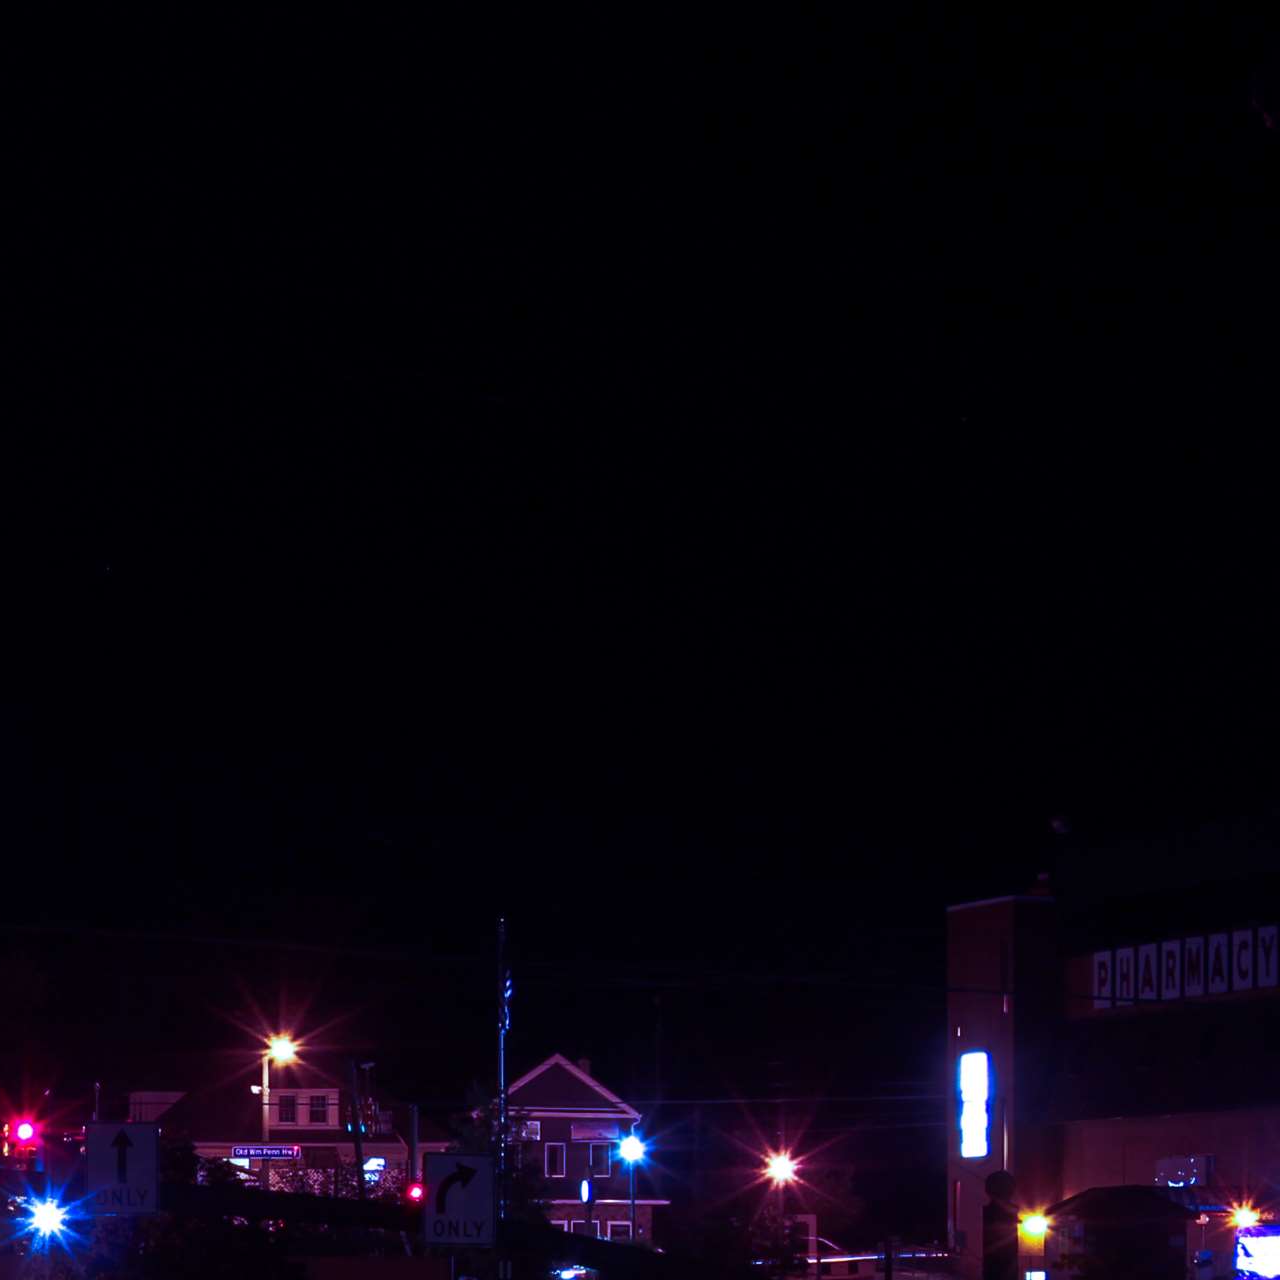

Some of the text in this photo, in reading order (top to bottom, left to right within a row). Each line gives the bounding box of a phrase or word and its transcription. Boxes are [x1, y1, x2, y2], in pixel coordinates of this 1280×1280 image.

[1097, 933, 1275, 998] PHARMACY
[96, 1188, 149, 1207] ONLY
[433, 1219, 484, 1238] ONLY
